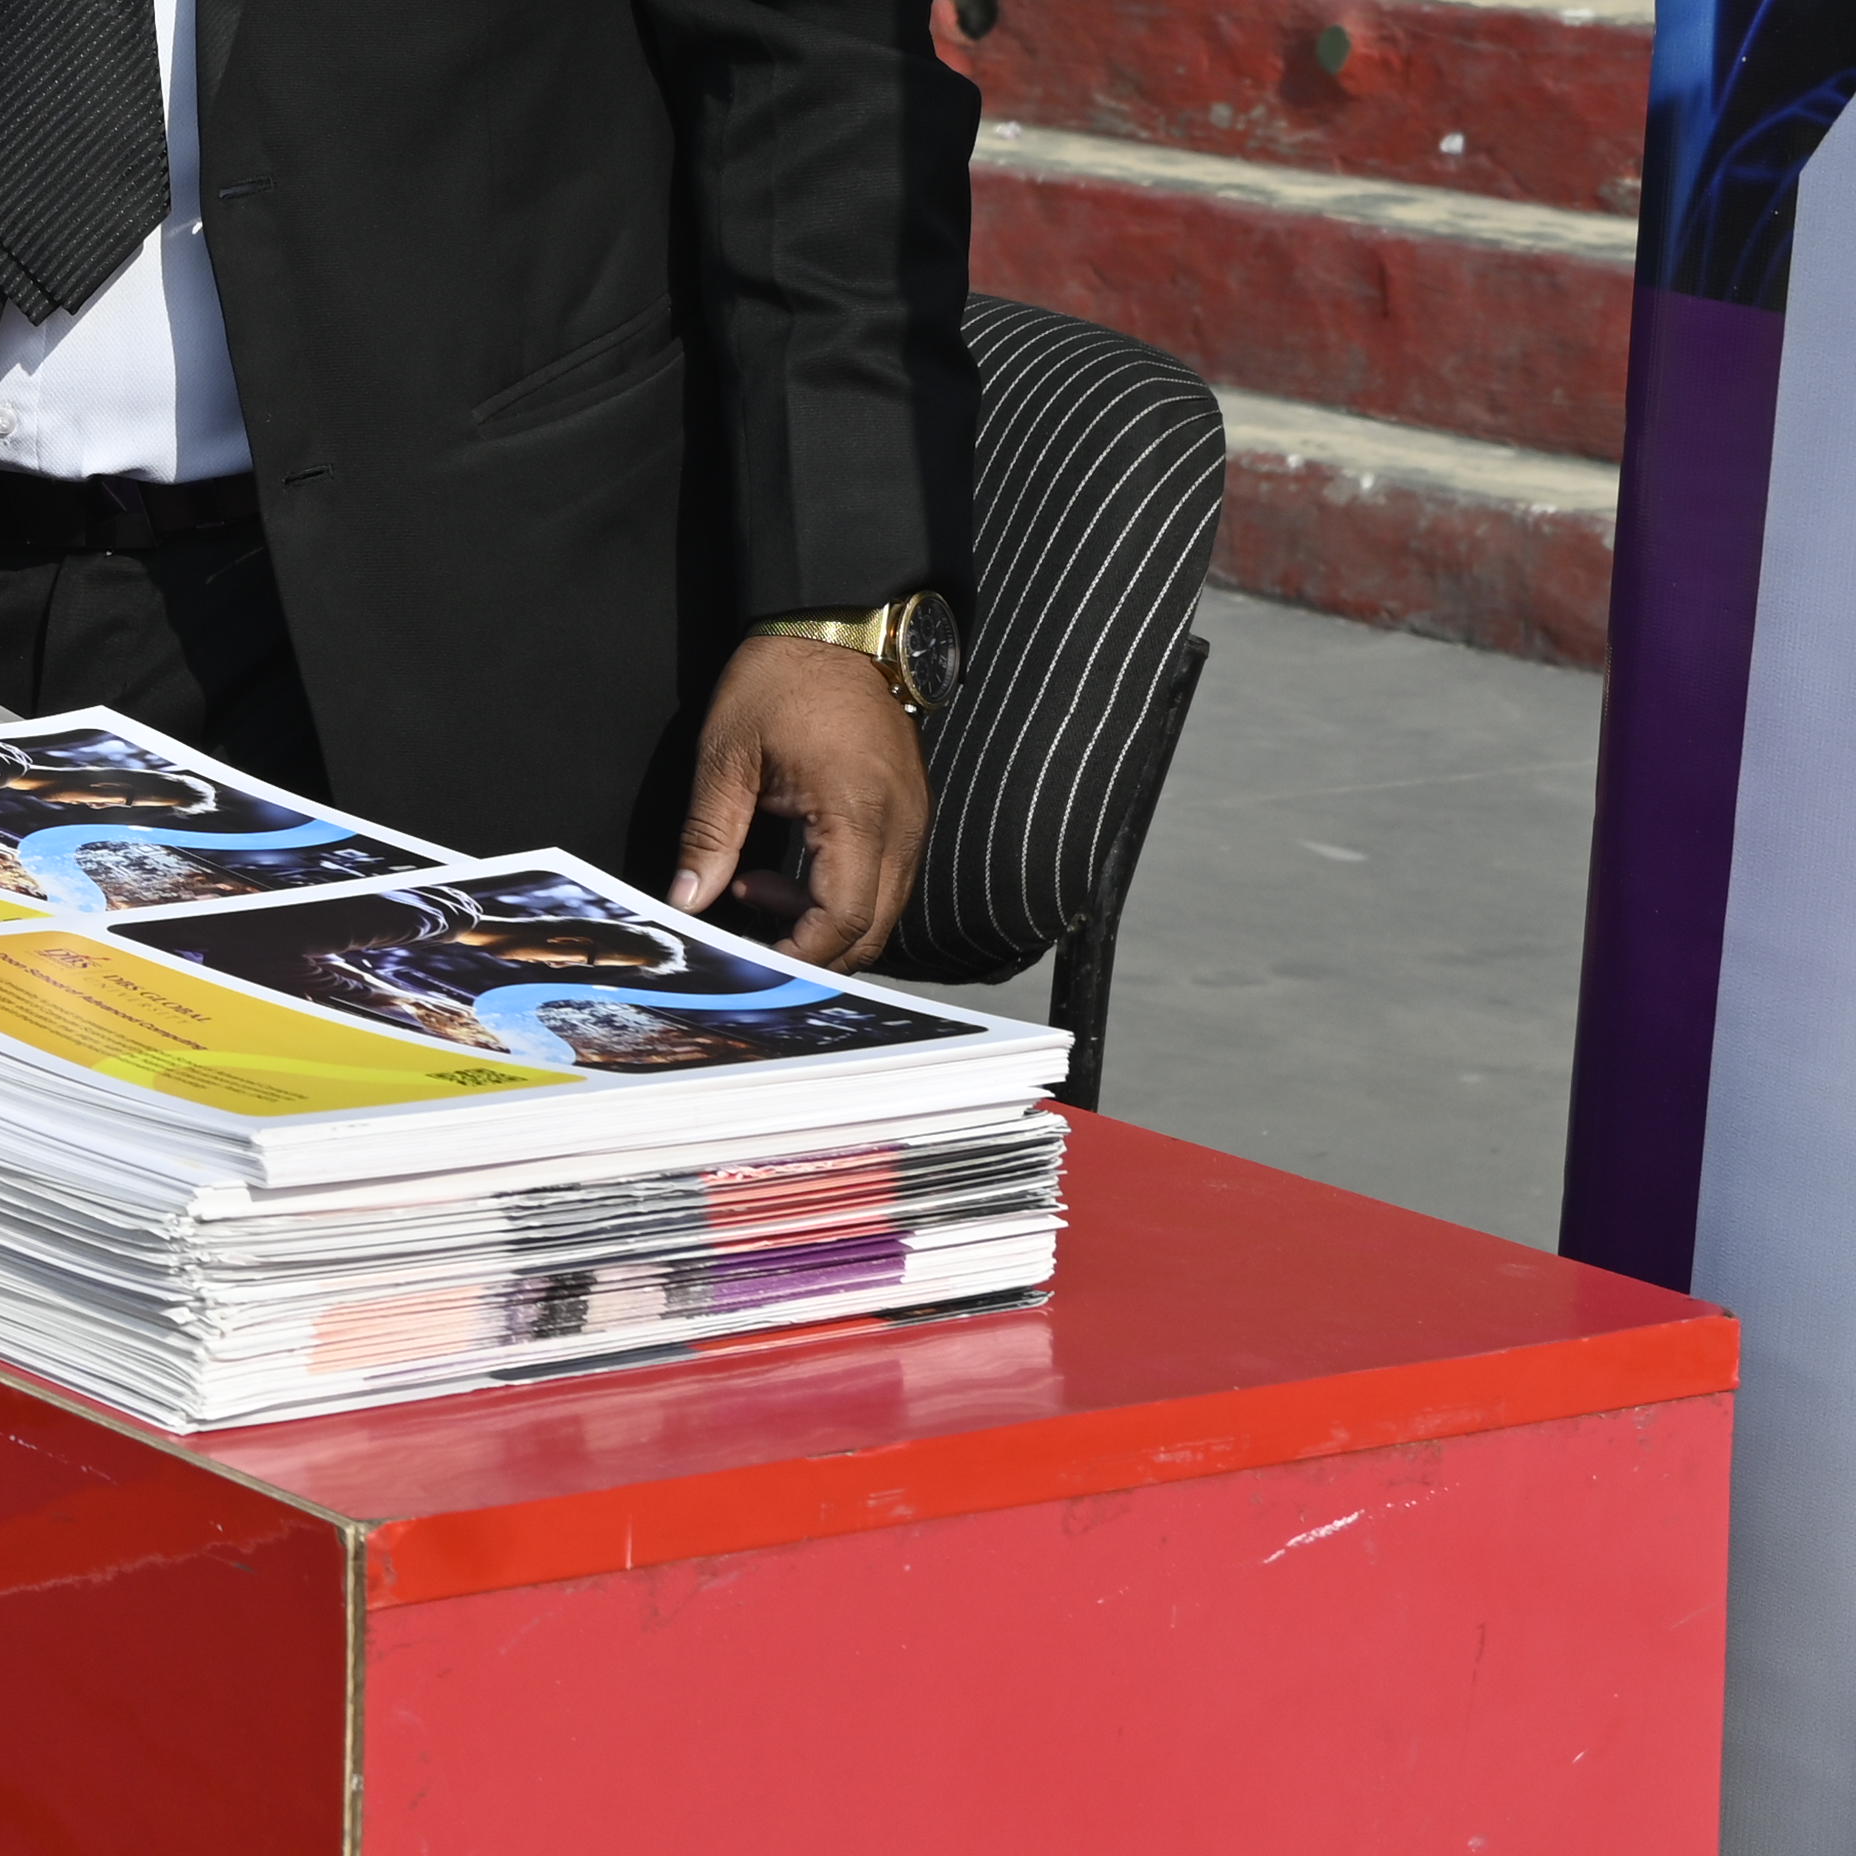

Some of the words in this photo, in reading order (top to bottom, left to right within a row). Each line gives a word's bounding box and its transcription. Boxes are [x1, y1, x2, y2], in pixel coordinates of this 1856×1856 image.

[41, 946, 97, 970] DBS
[21, 966, 69, 990] School
[79, 994, 145, 1025] Advanced
[137, 1021, 210, 1053] Computing
[100, 974, 147, 994] DBS
[136, 990, 216, 1024] GLOBAL
